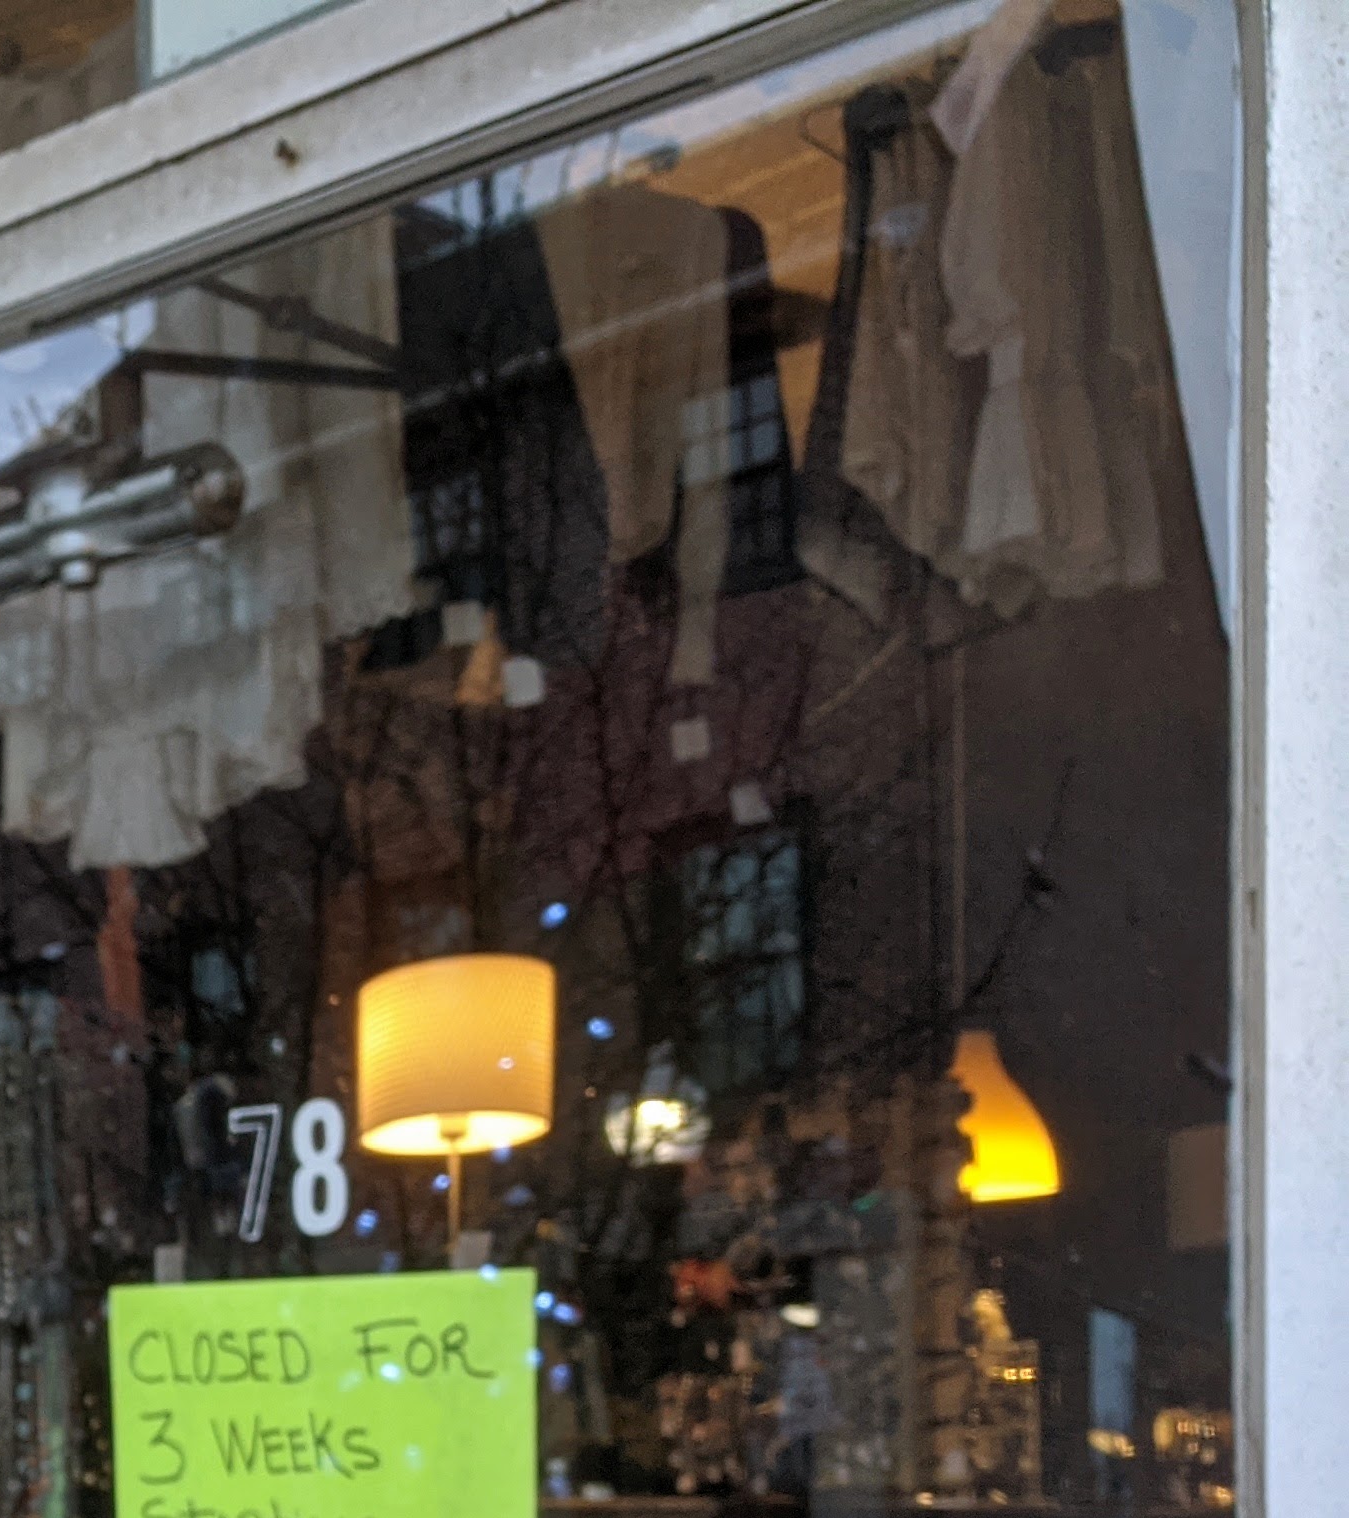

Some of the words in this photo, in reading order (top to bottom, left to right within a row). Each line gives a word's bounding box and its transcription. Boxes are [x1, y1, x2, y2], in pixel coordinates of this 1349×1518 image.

[229, 1097, 349, 1242] 78
[129, 1327, 311, 1384] CLOSED
[354, 1317, 496, 1380] FOR
[139, 1409, 187, 1486] 3
[210, 1409, 381, 1480] WEEKS
